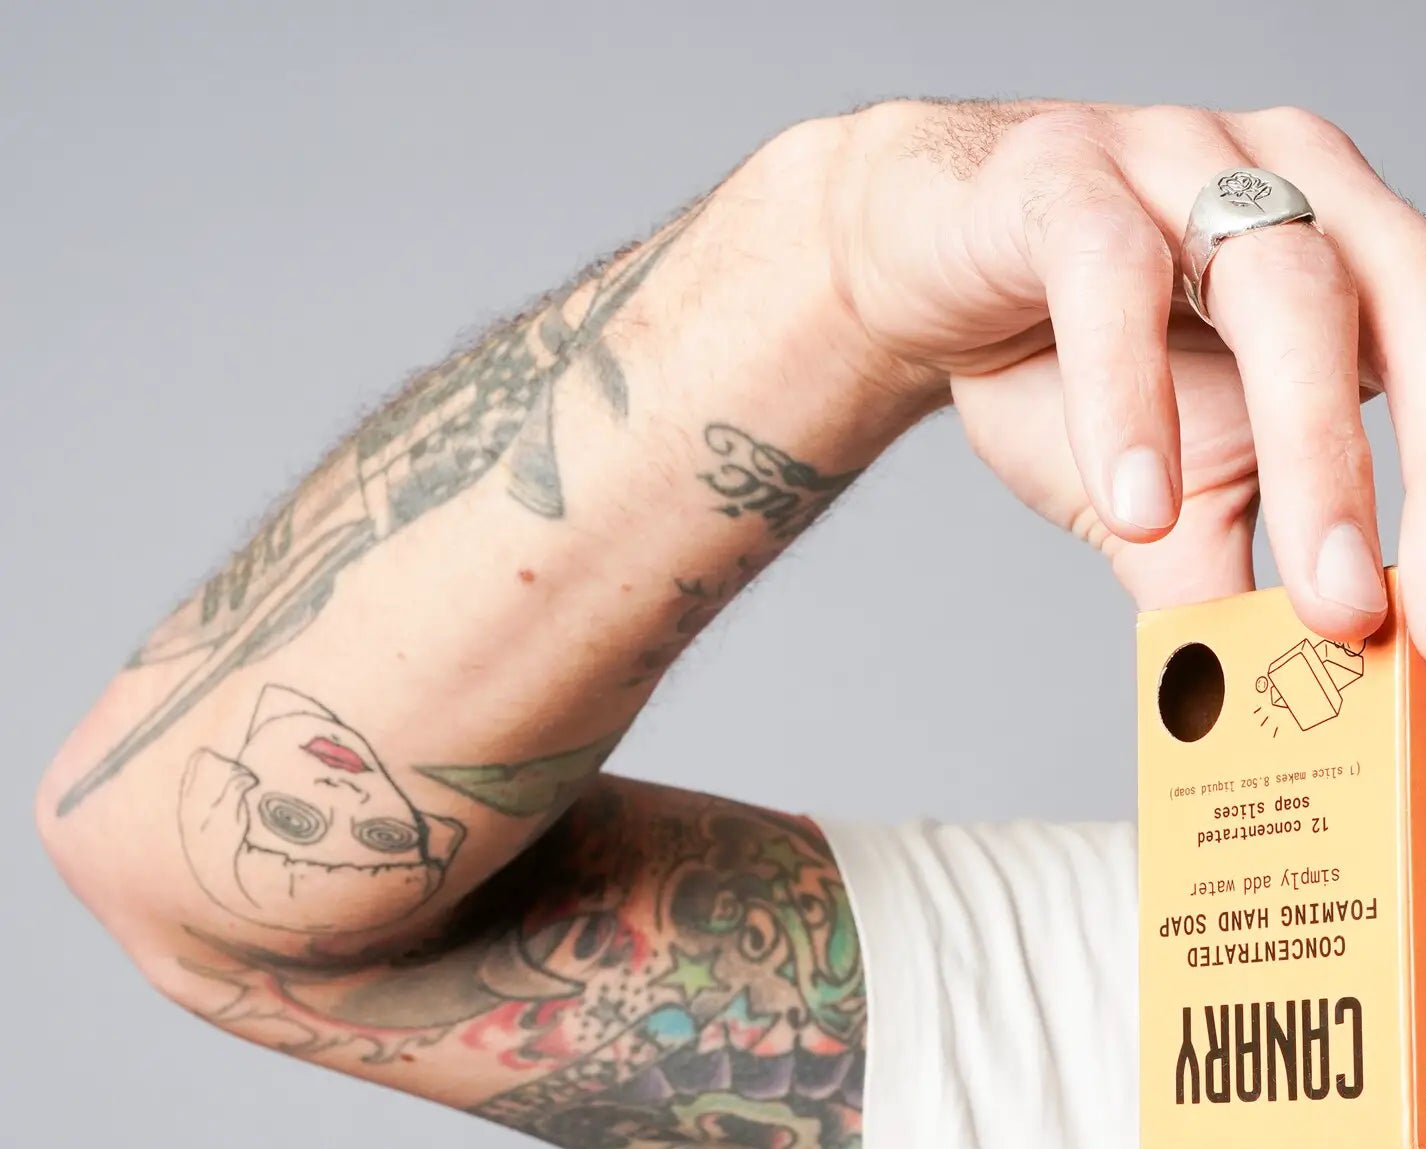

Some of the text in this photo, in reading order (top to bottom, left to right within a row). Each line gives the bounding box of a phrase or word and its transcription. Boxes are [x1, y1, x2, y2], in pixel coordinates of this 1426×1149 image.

[1169, 761, 1361, 800] (1 slice makes 8.5oz liquid soap)
[1214, 796, 1310, 820] soap slices
[1197, 817, 1329, 847] 12 concentrated
[1190, 868, 1340, 896] simply add water
[1159, 898, 1378, 937] FOAMING HAND SOAP
[1187, 935, 1346, 967] CONCENTRATED
[1176, 996, 1364, 1104] CANARY
